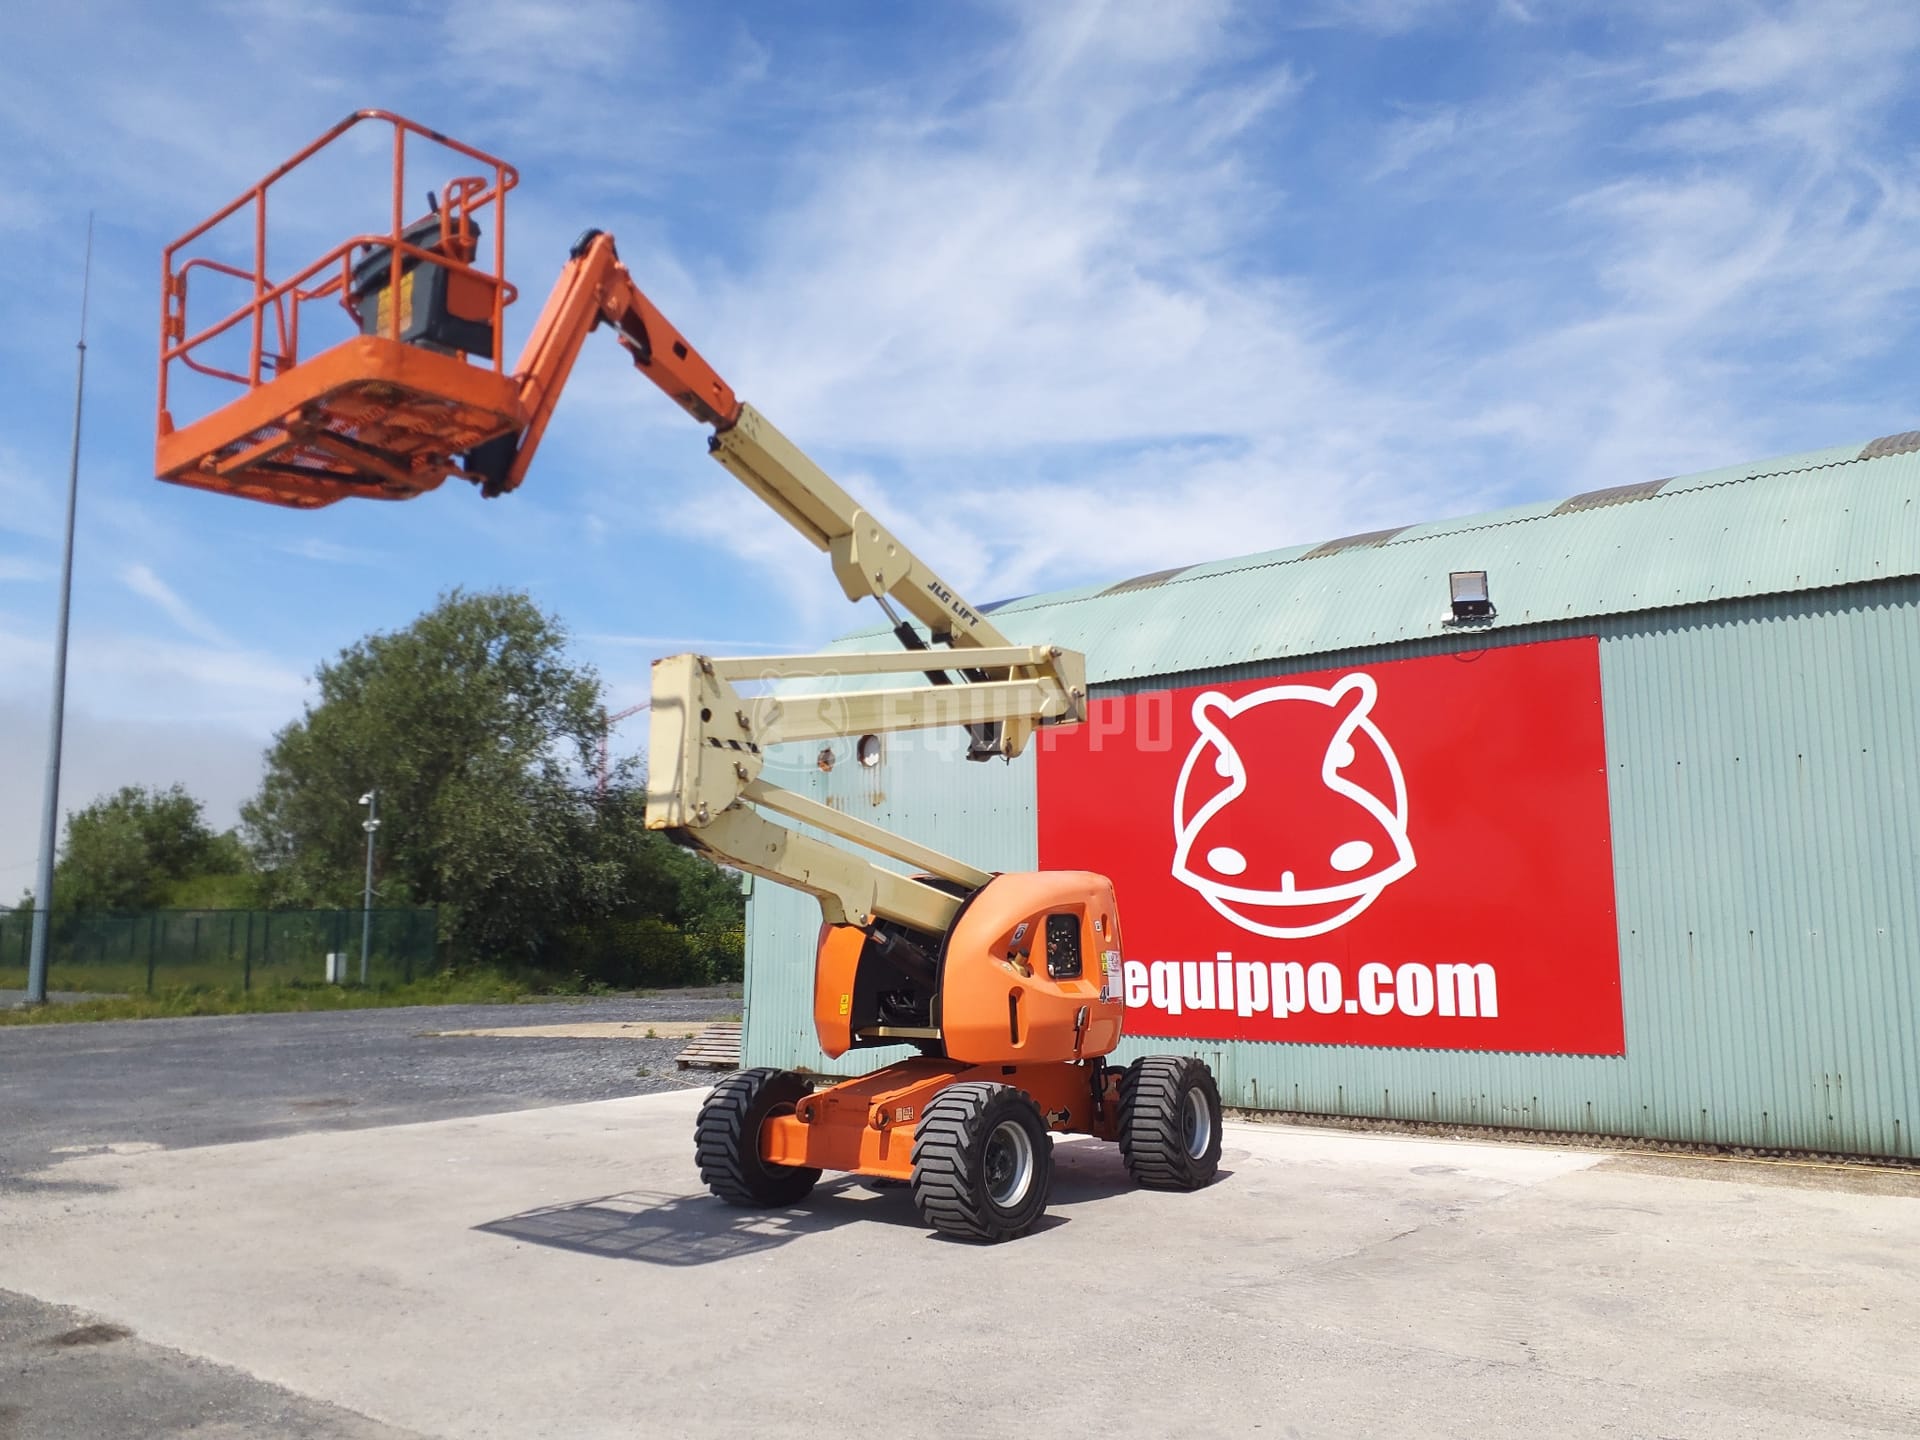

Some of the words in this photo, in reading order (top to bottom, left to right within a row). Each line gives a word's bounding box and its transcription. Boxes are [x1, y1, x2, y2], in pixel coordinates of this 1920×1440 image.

[927, 581, 952, 604] JLG
[951, 600, 979, 627] LIFT
[1123, 951, 1498, 1018] equippo.com
